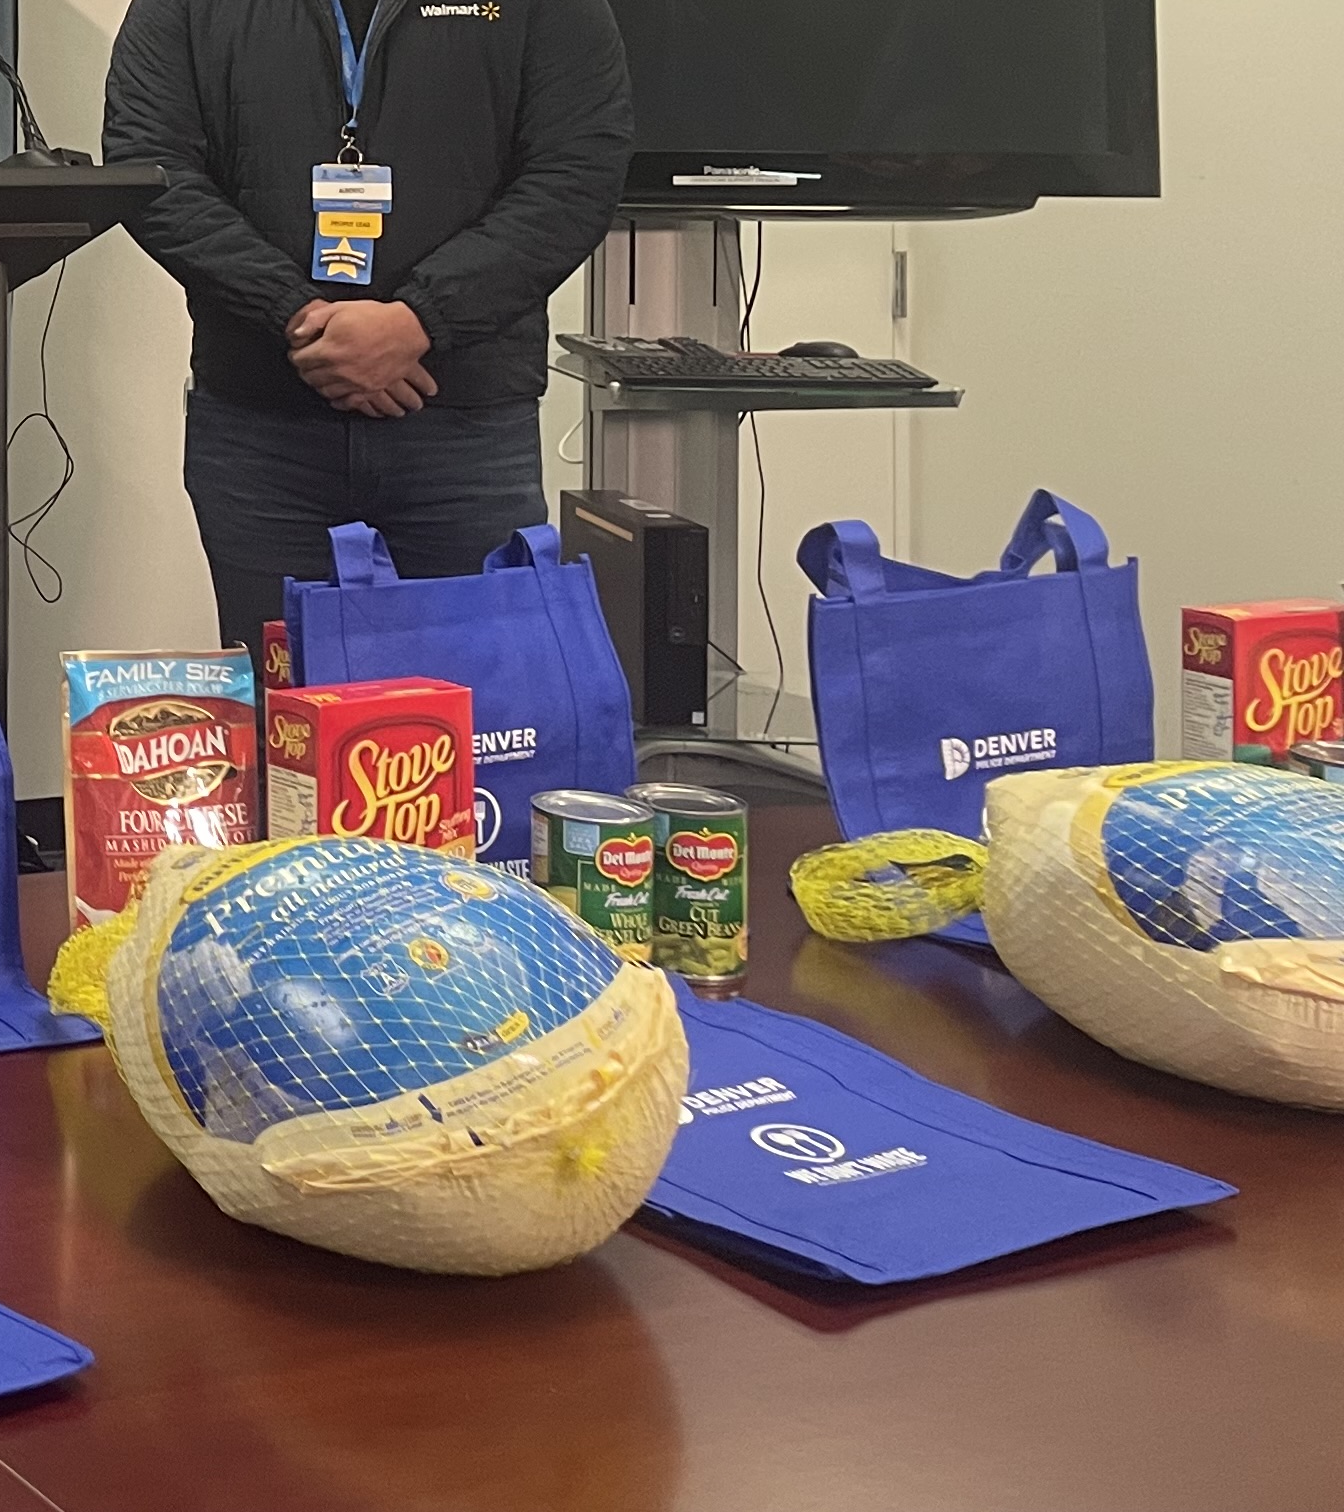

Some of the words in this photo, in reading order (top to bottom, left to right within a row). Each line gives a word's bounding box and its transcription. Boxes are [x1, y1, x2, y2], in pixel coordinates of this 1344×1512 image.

[420, 3, 480, 18] Walmart
[85, 661, 178, 692] FAMILY
[185, 663, 235, 684] SIZE
[1245, 646, 1344, 732] Stove
[1282, 695, 1334, 750] Top
[112, 724, 228, 775] IDAHOAN
[283, 737, 307, 760] Top
[472, 727, 537, 755] ENVER
[974, 728, 1057, 758] DENVER
[331, 734, 456, 838] Stove
[119, 809, 166, 834] FOUR
[377, 793, 440, 846] Top
[602, 851, 624, 866] Del
[672, 843, 695, 860] Del
[695, 845, 735, 861] Monte
[689, 905, 720, 924] CUT
[681, 1076, 787, 1109] DENVER
